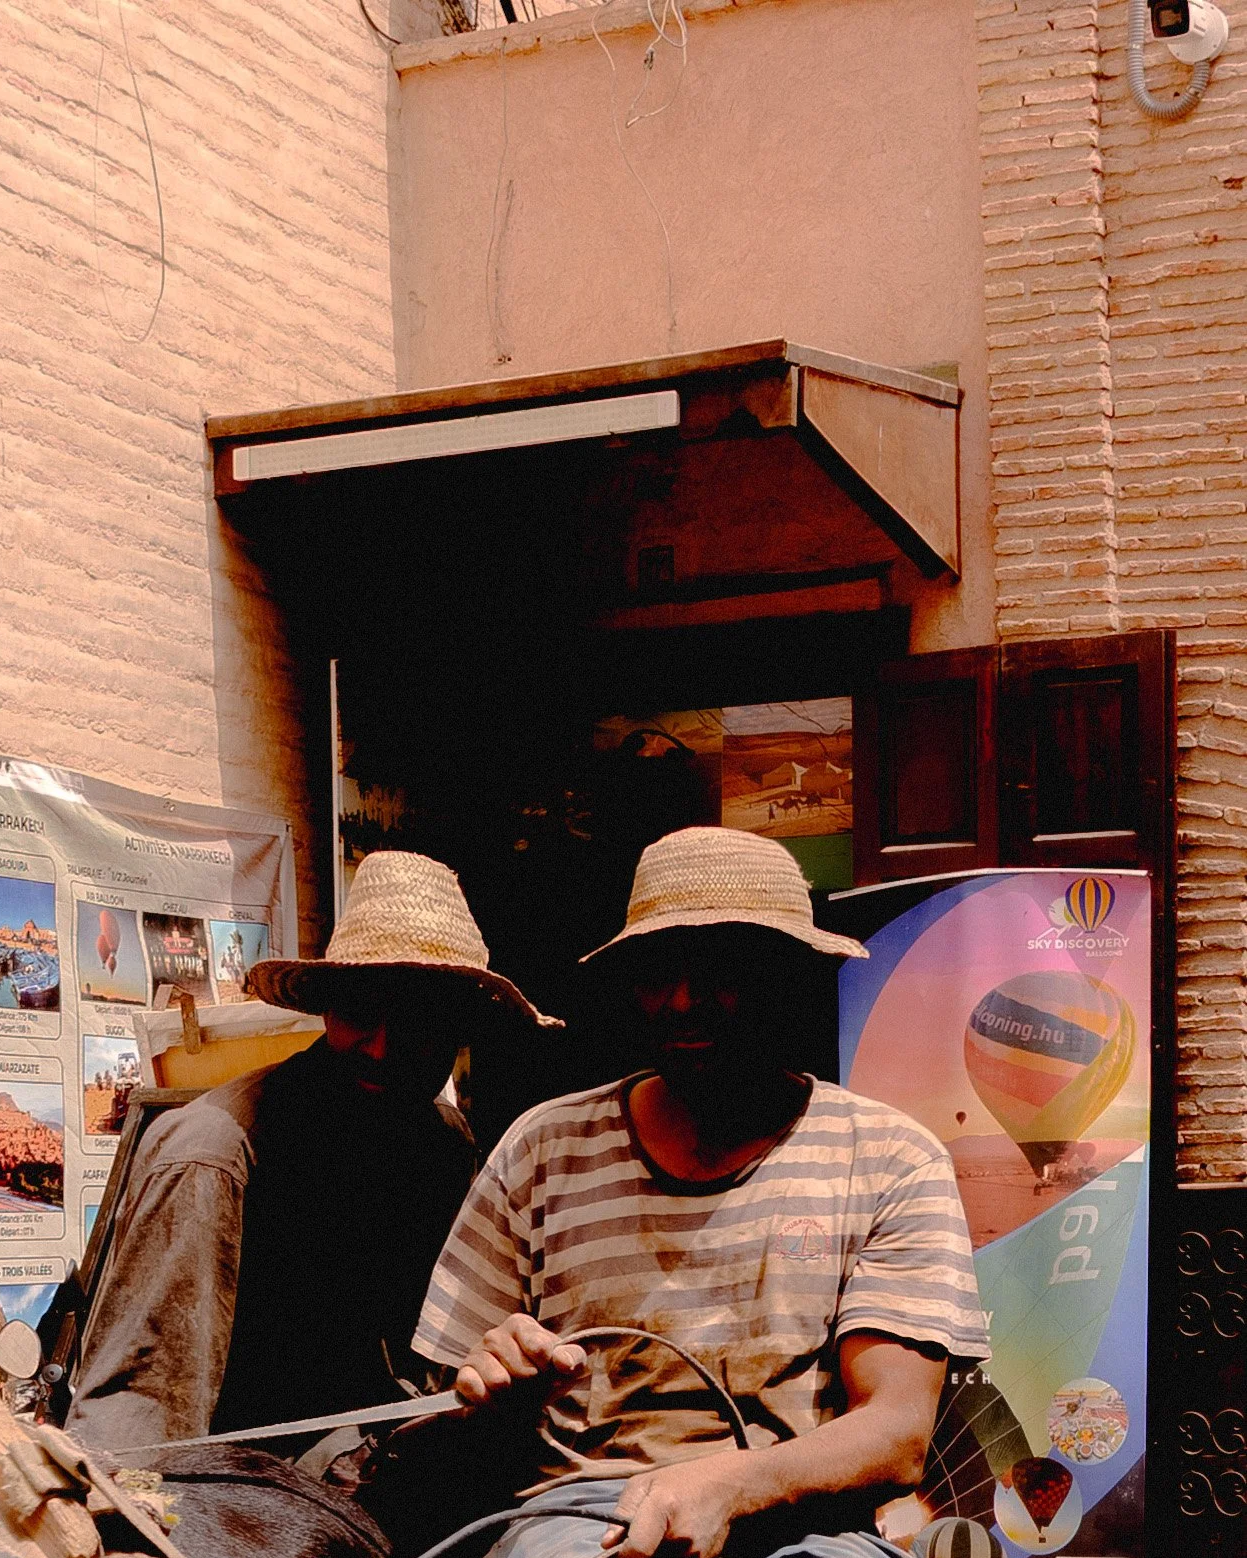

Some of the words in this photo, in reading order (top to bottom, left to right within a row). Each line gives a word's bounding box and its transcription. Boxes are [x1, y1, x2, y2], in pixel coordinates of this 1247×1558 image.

[178, 846, 232, 865] MARRAKECH
[1027, 939, 1053, 950] SKY
[1055, 937, 1130, 950] DISCOVERY
[2, 1265, 24, 1277] TROIS
[24, 1263, 53, 1277] VALLÉES
